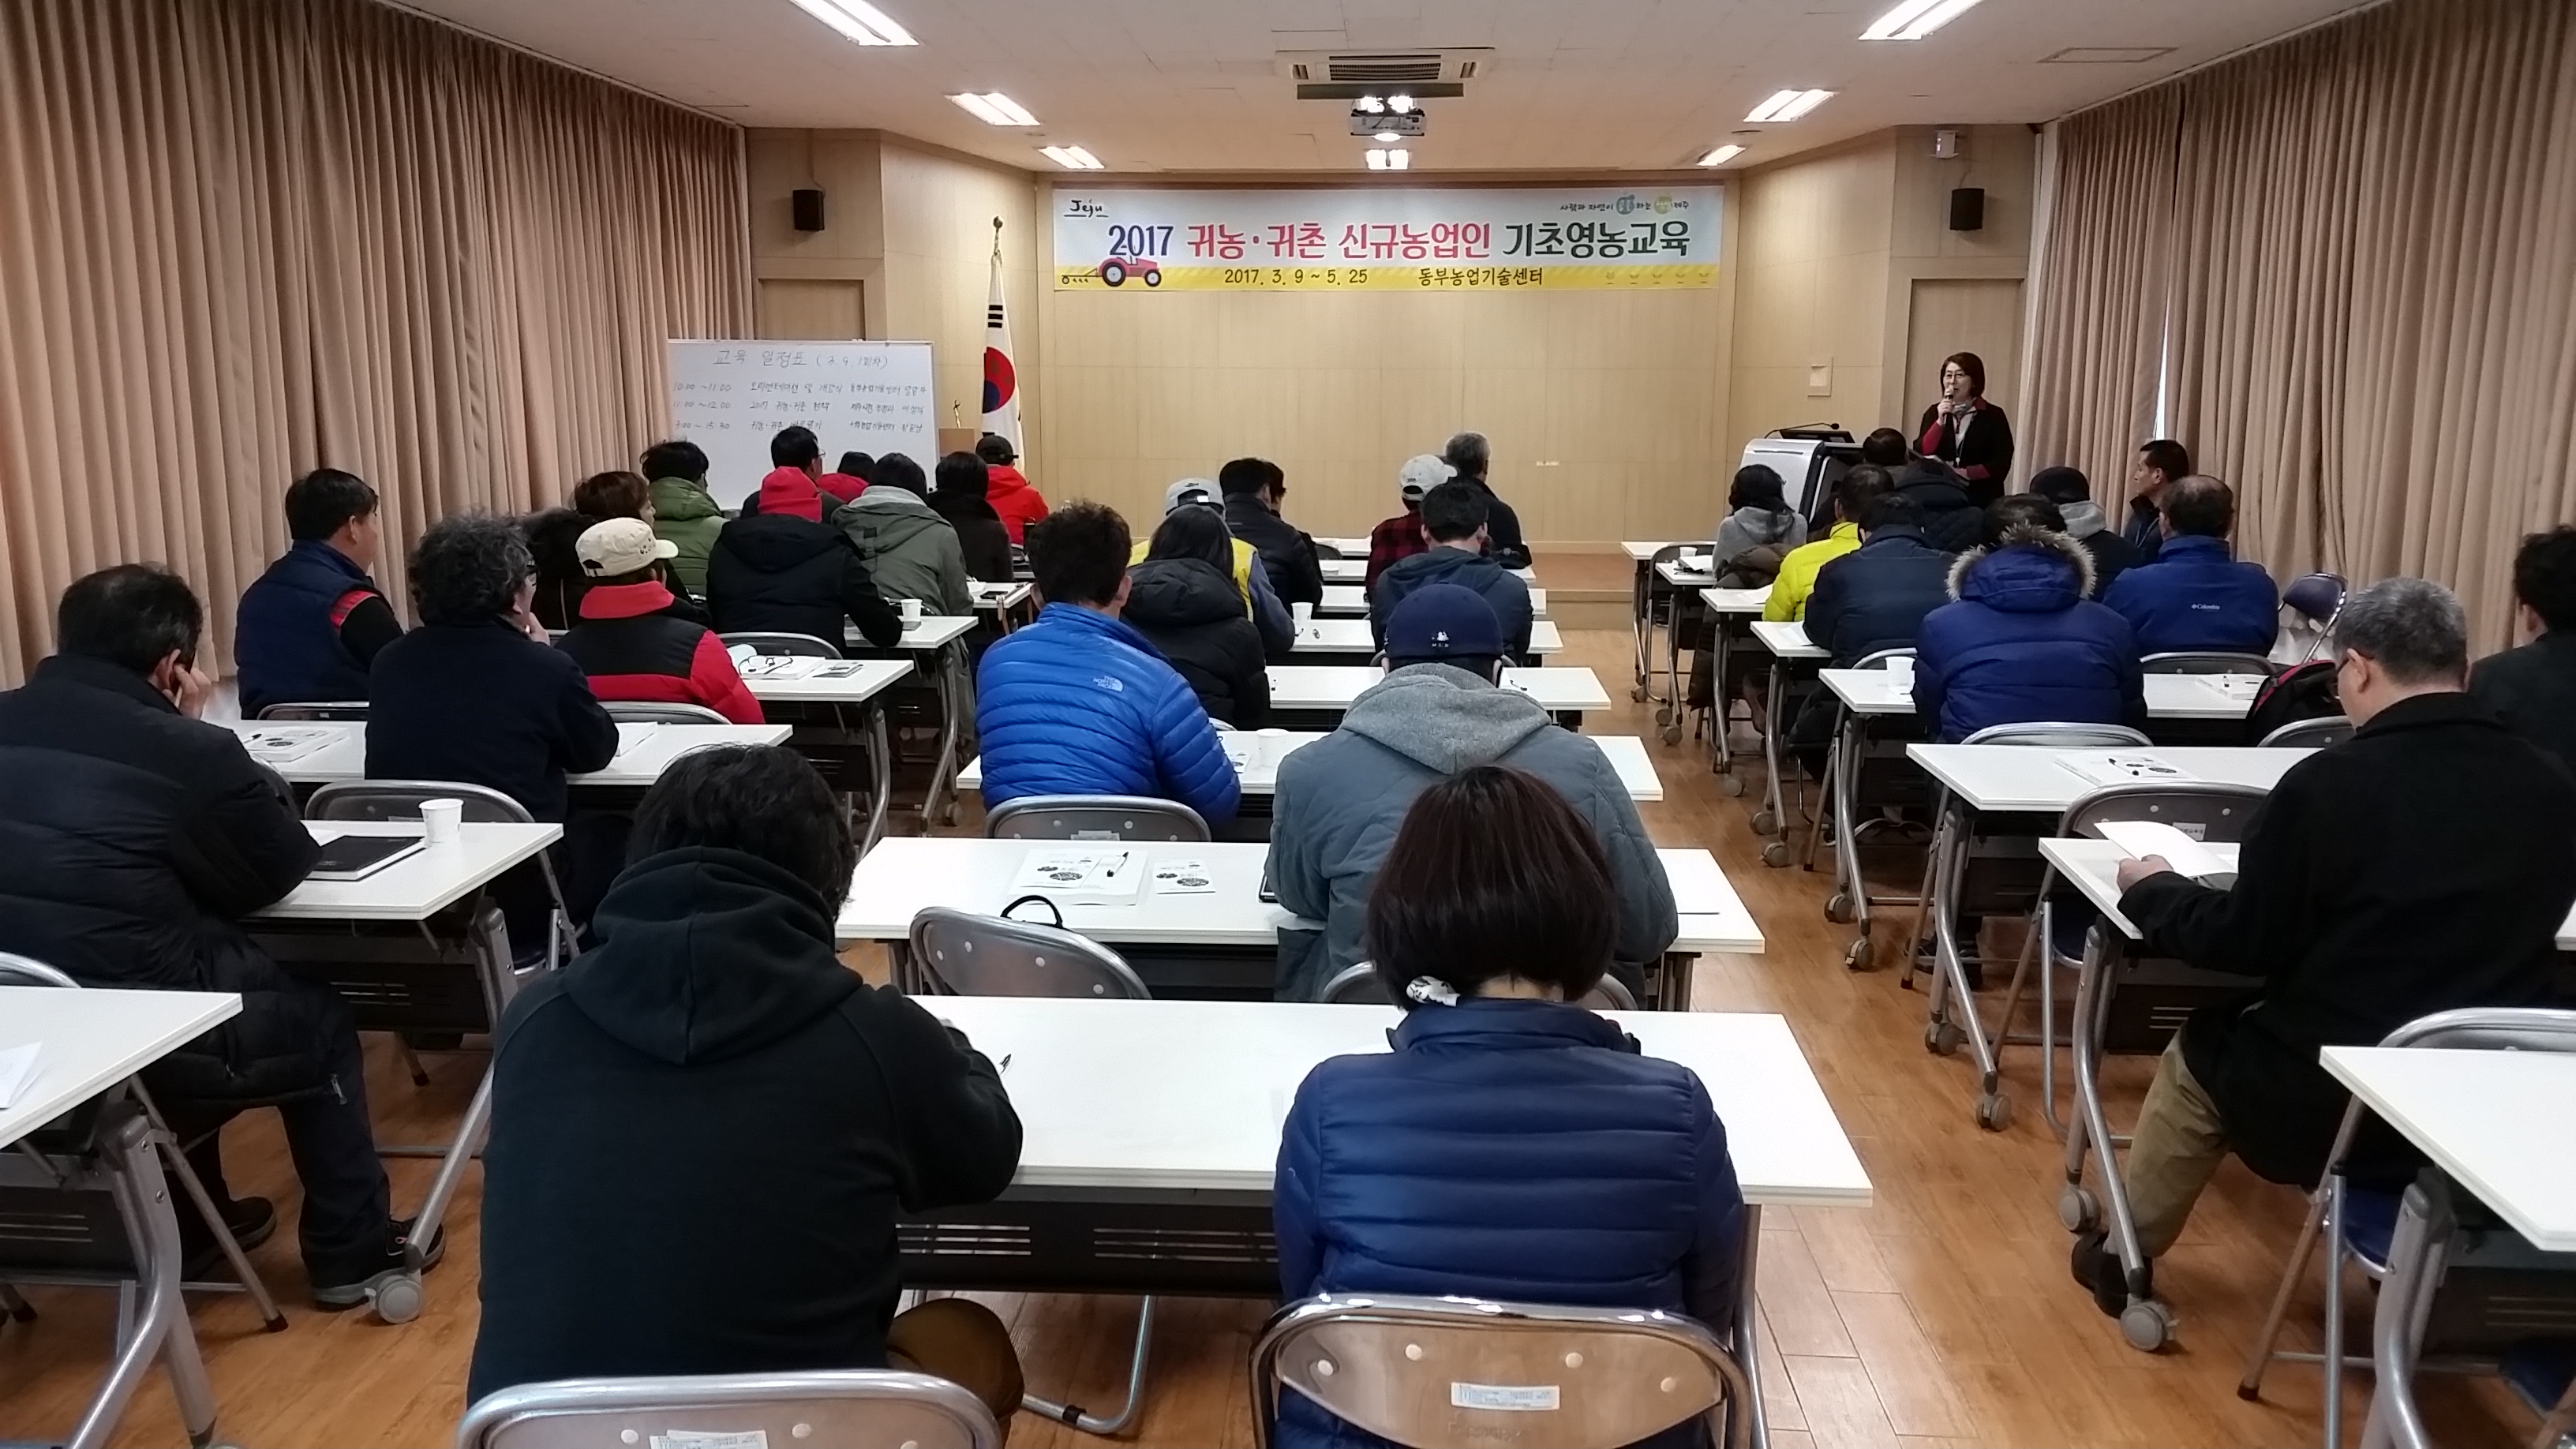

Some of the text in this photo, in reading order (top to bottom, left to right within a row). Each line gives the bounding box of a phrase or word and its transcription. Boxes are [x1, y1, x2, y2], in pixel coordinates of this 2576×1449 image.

[1069, 197, 1103, 218] Jeju
[1588, 203, 1614, 212] 자연이
[1673, 200, 1689, 211] 제주
[1108, 220, 1691, 260] 2017 귀농·귀촌 신규농업인 기초영농교육
[1348, 268, 1368, 285] 25
[1417, 267, 1544, 286] 동부농업기술센터
[762, 350, 807, 368] 일정표
[750, 381, 799, 394] 오리엔테이션
[804, 383, 813, 394] 및
[749, 401, 769, 410] 2017
